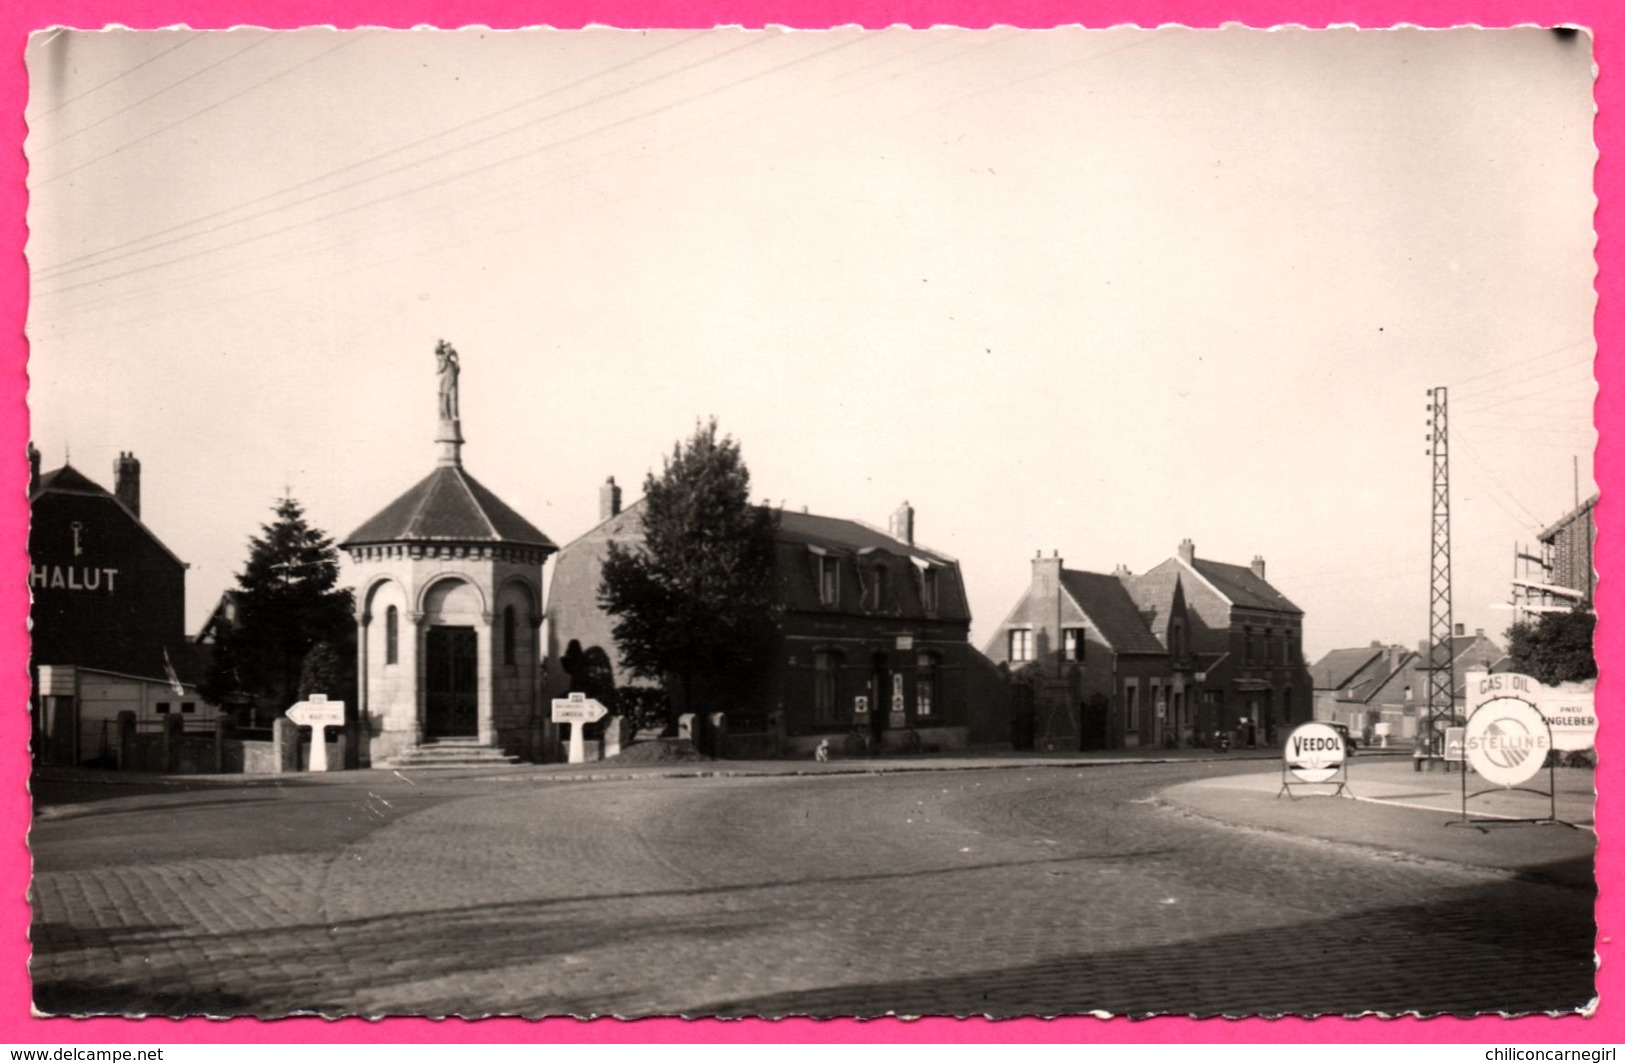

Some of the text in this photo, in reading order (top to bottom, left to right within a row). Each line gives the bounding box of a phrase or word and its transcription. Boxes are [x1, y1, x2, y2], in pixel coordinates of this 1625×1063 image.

[30, 564, 118, 591] HALUT
[1480, 675, 1531, 694] GAS OIL
[1544, 715, 1595, 726] NGLEBER
[1293, 736, 1341, 757] VEEDOL
[1468, 735, 1547, 751] STELLINE
